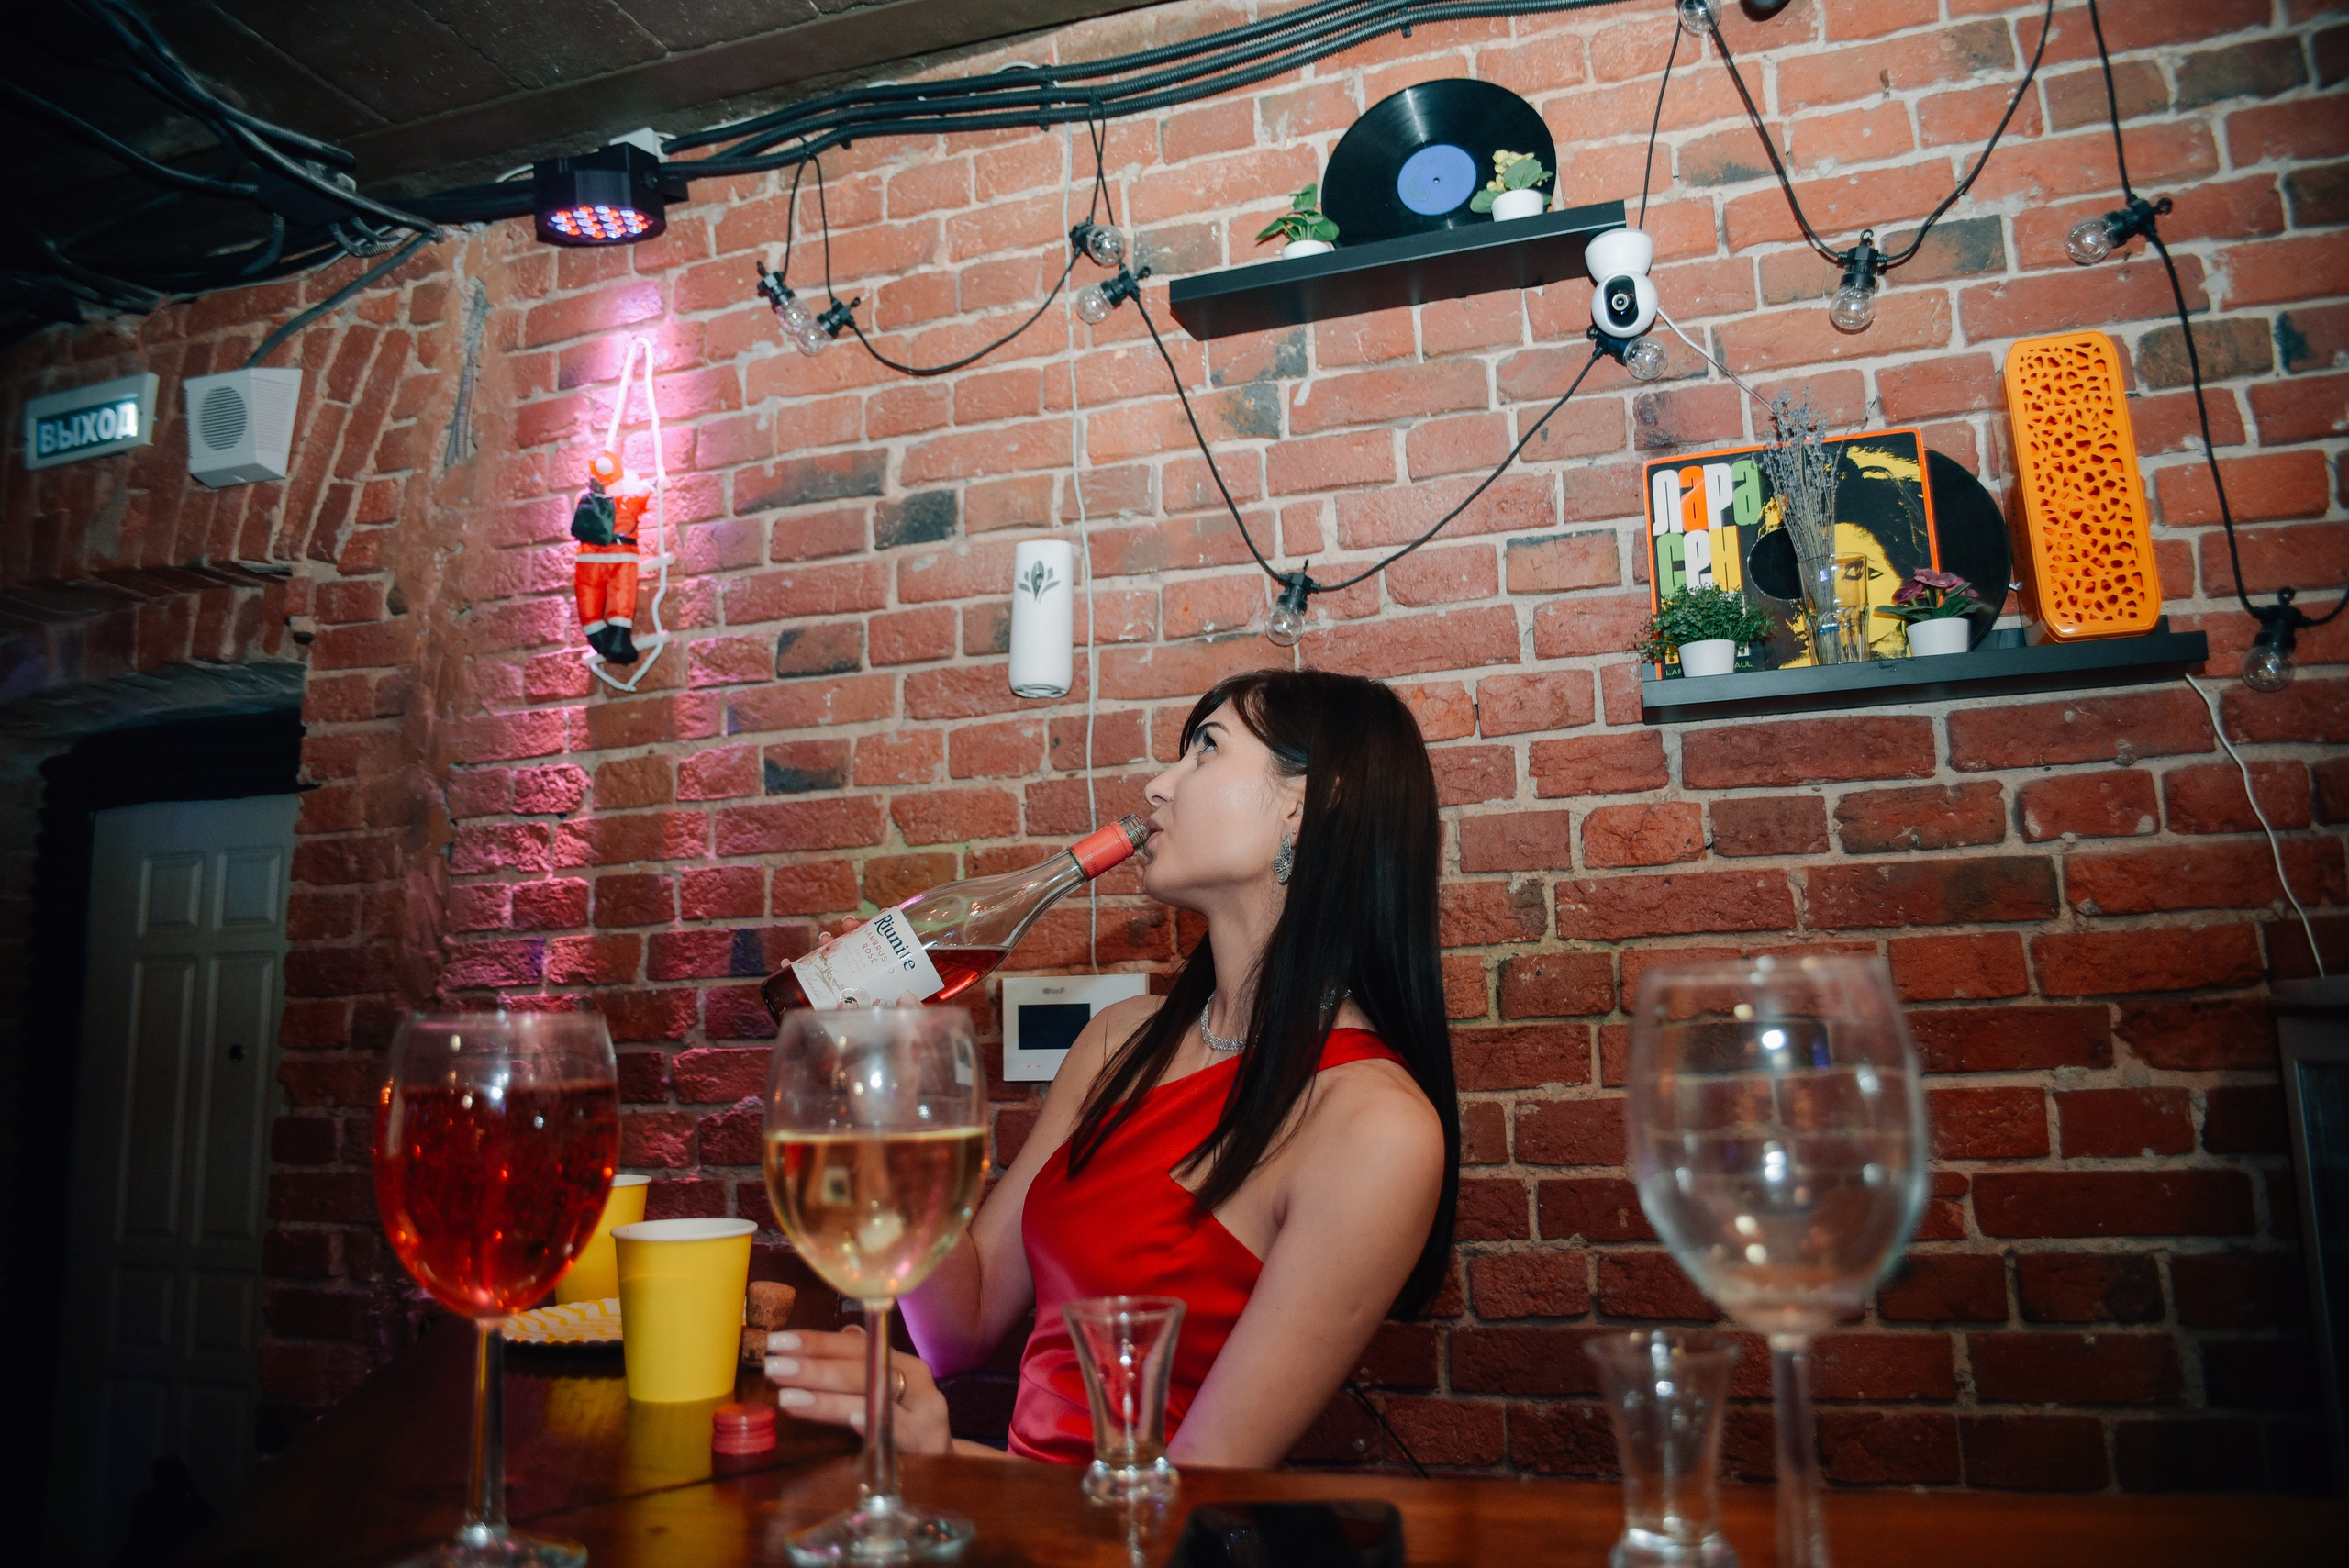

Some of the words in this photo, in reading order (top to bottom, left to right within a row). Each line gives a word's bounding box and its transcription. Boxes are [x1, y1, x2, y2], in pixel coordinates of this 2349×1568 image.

[39, 402, 138, 454] ВЫХОД
[862, 943, 878, 964] ROSÉ
[864, 928, 895, 973] LAMBRUSCO
[874, 914, 916, 971] Riunite
